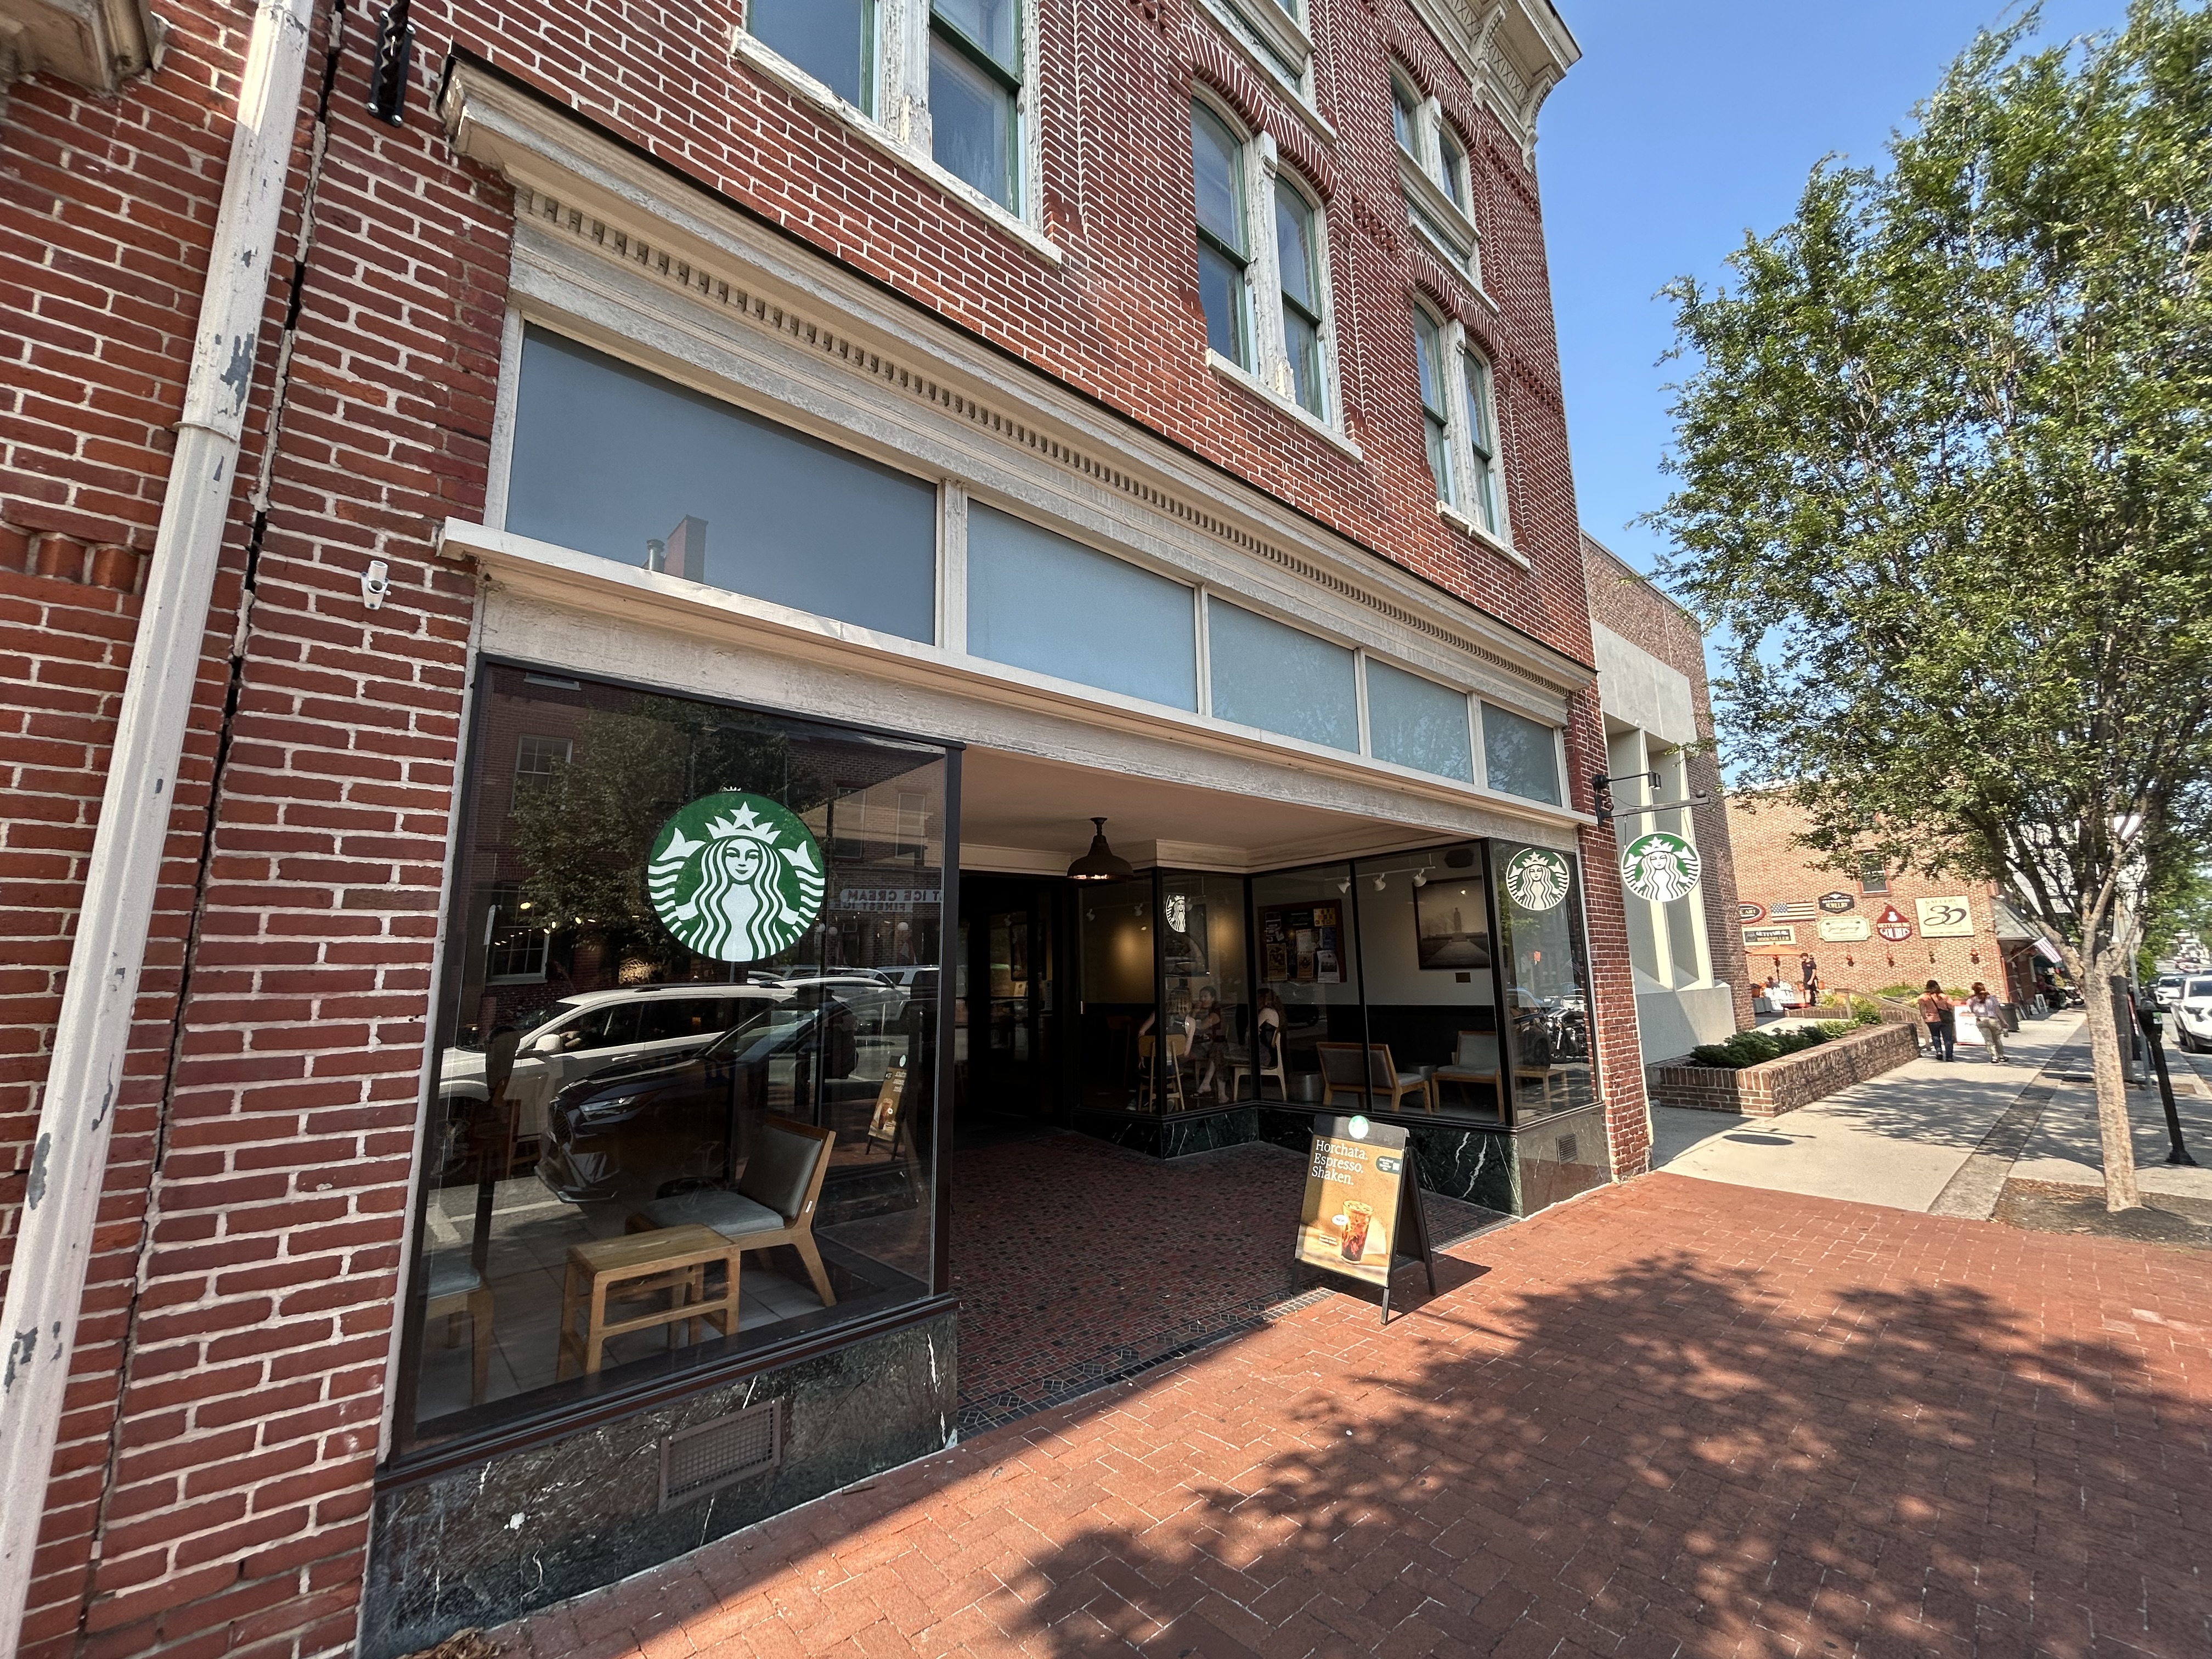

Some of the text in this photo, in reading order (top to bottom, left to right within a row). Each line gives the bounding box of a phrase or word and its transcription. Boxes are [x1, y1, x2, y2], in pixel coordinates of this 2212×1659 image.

[1316, 1139, 1368, 1160] Horchata.
[1313, 1153, 1364, 1173] Espresso.
[1311, 1165, 1355, 1186] Shaken.
